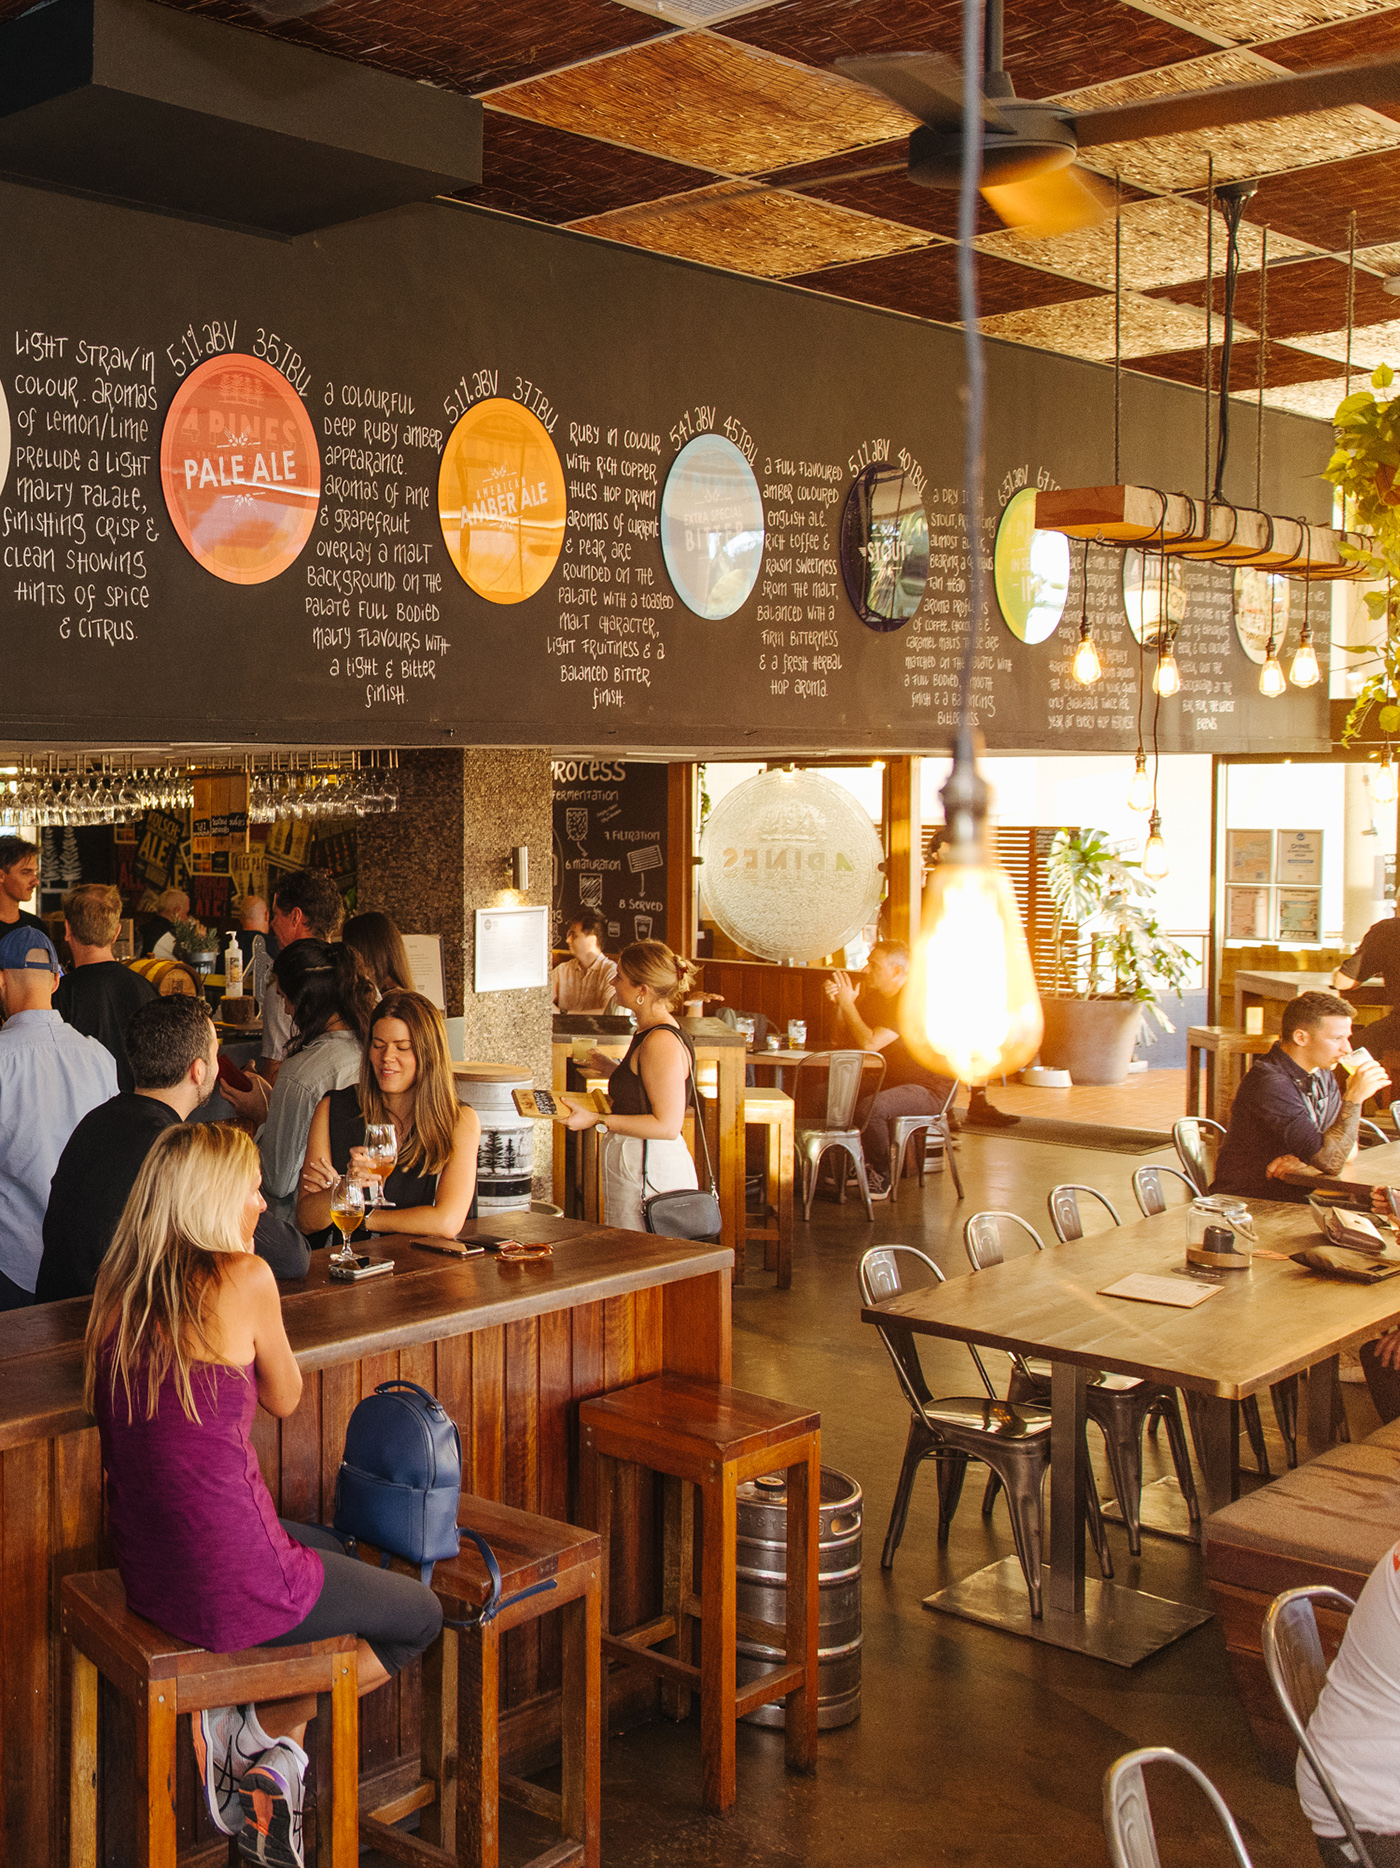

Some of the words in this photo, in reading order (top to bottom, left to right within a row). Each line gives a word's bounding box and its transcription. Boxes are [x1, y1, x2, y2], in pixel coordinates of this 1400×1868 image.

[184, 455, 246, 490] PALE
[252, 450, 297, 483] ALE
[476, 477, 526, 499] AMERICAN
[460, 492, 517, 529] AMBER
[521, 481, 548, 510] ALE
[684, 511, 709, 526] EXTRA
[710, 505, 743, 521] SPECIAL
[867, 541, 907, 562] STOUT
